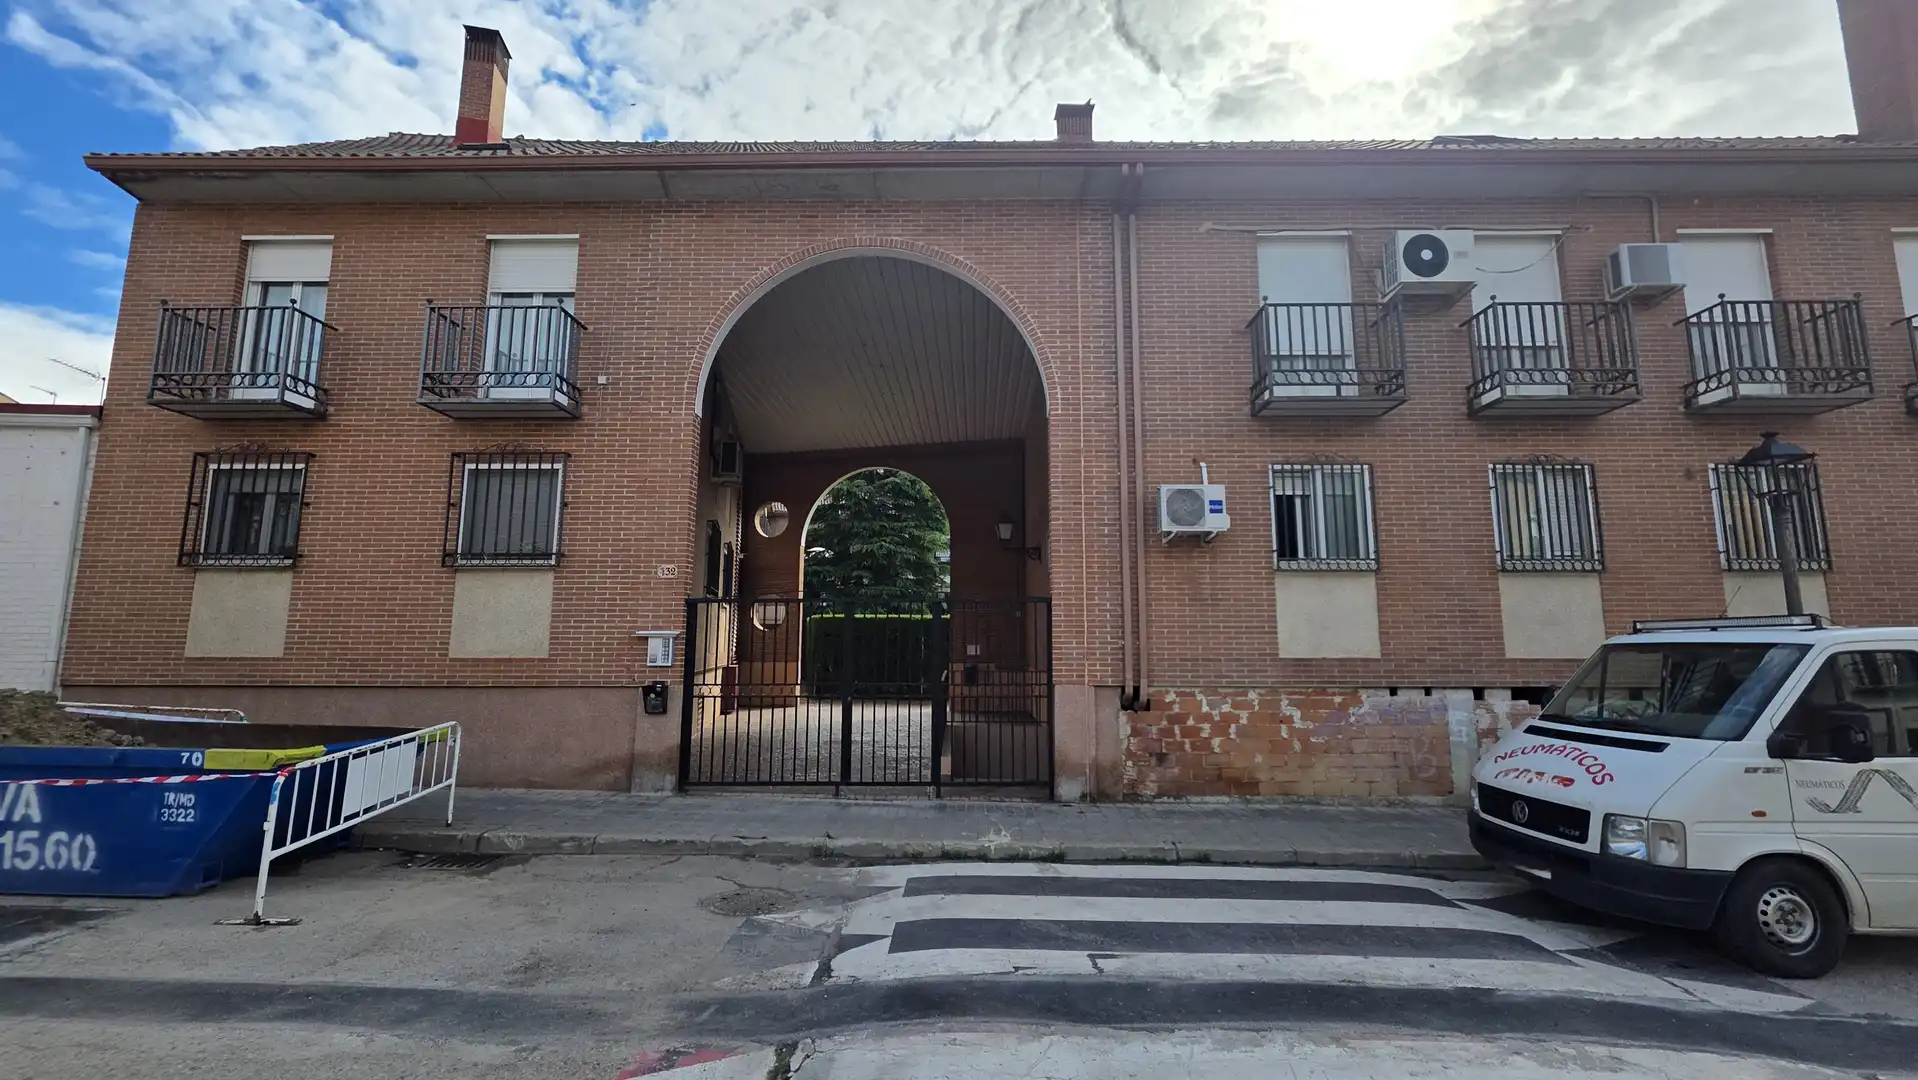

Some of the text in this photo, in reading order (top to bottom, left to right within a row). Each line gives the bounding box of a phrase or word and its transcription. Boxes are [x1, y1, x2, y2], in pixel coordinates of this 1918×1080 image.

[1494, 742, 1614, 786] NEUMÁTICOS
[1796, 779, 1846, 790] NEUMÁTICOS
[163, 792, 195, 809] TR/MD
[160, 808, 195, 822] 3322
